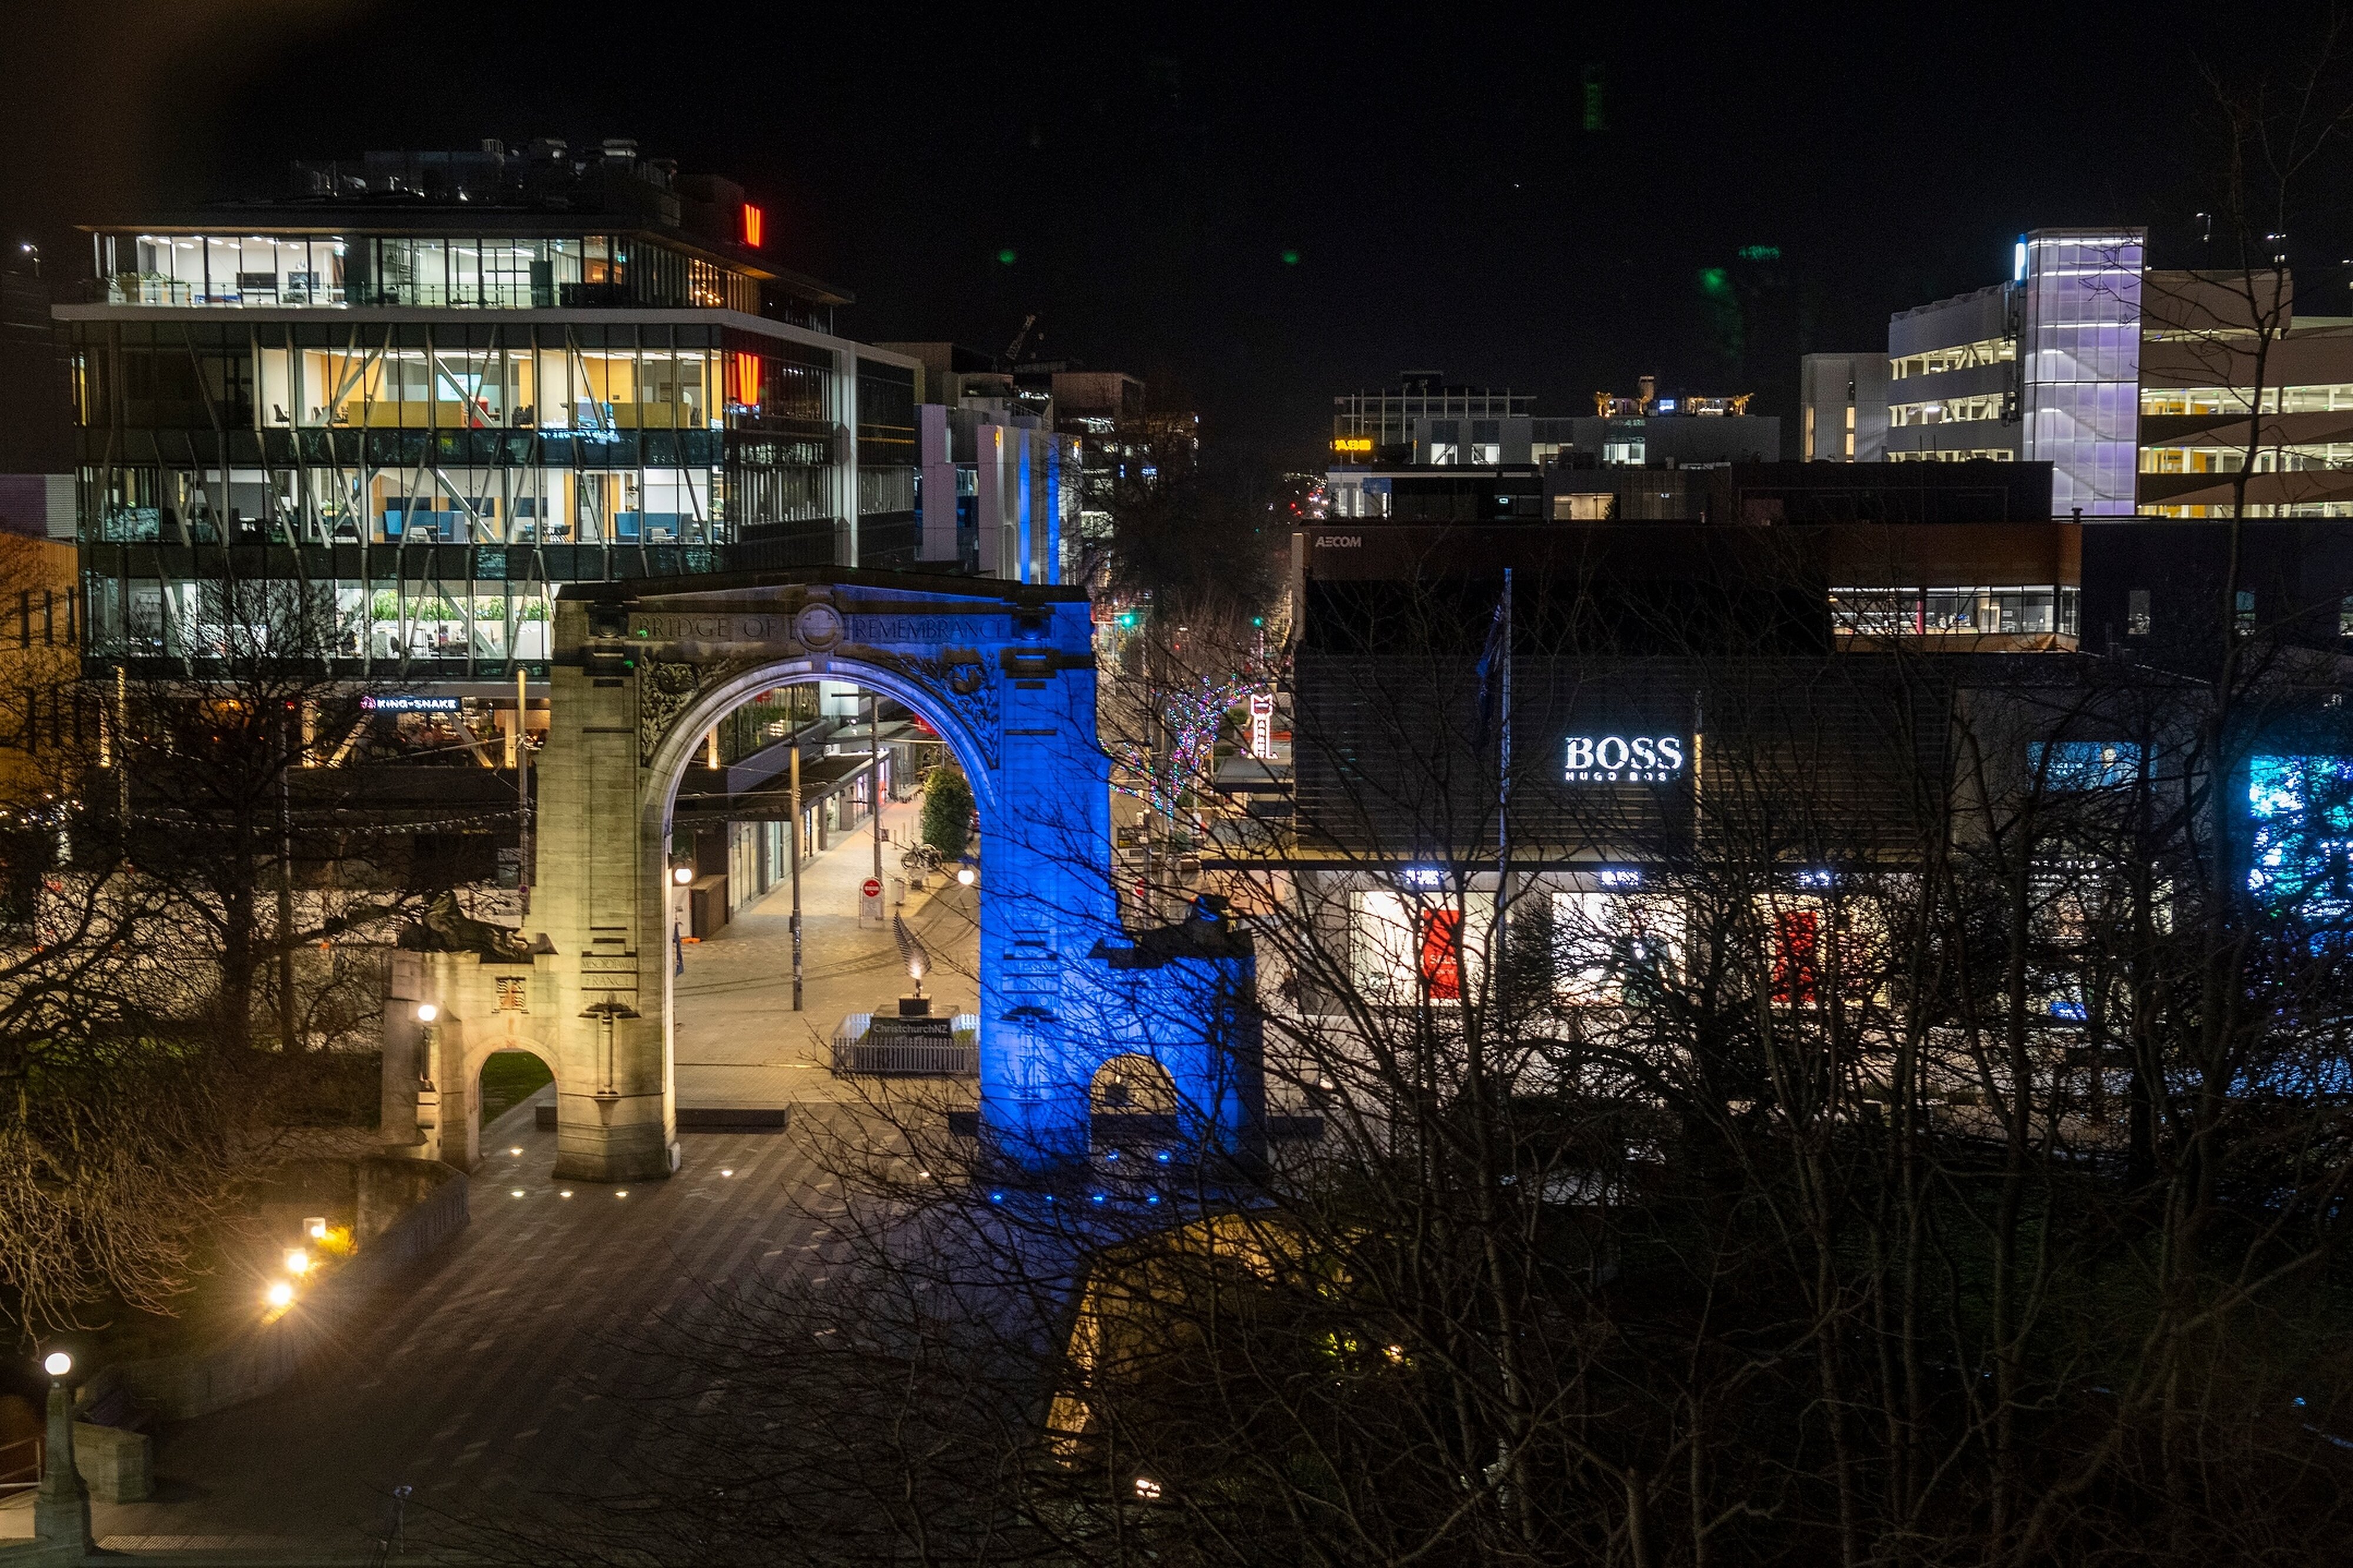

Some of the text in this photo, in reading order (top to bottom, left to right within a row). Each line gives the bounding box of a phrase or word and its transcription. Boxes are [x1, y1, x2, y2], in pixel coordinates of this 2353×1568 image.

[1315, 536, 1362, 547] AECOM
[639, 617, 1007, 639] BRIDGE OF REMEMBRANCE
[377, 699, 408, 709] KING
[414, 699, 456, 710] SNAKE
[1565, 736, 1683, 770] BOSS
[1565, 771, 1618, 781] HUGO
[586, 975, 630, 987] FRANCE
[873, 1024, 948, 1034] ChristchurchNZ
